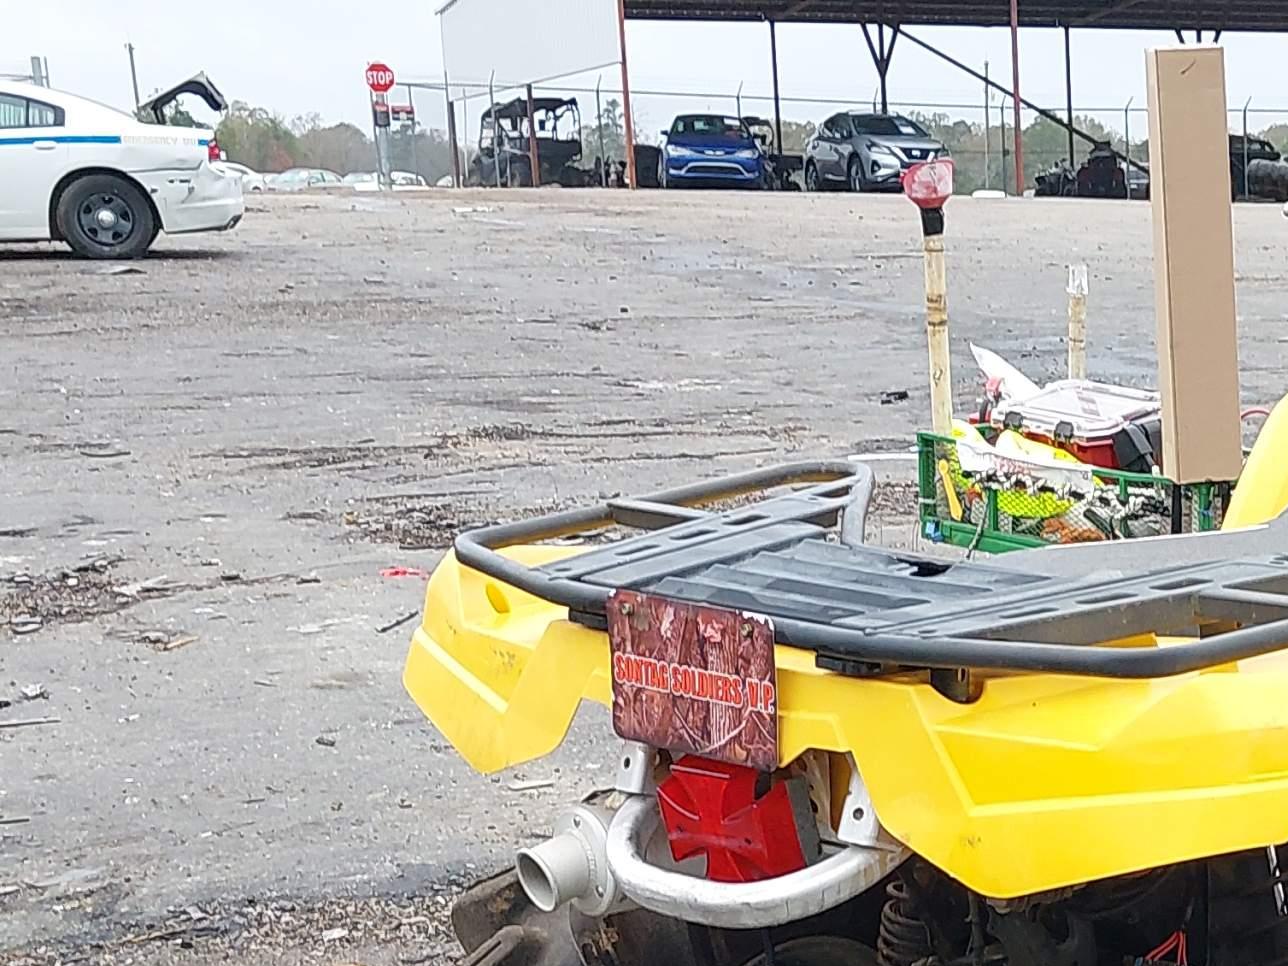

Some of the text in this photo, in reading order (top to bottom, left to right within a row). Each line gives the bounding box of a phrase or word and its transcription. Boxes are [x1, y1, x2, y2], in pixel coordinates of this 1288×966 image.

[366, 70, 393, 86] STOP
[614, 652, 670, 693] SONTAG
[671, 664, 744, 706] SOLDIERS
